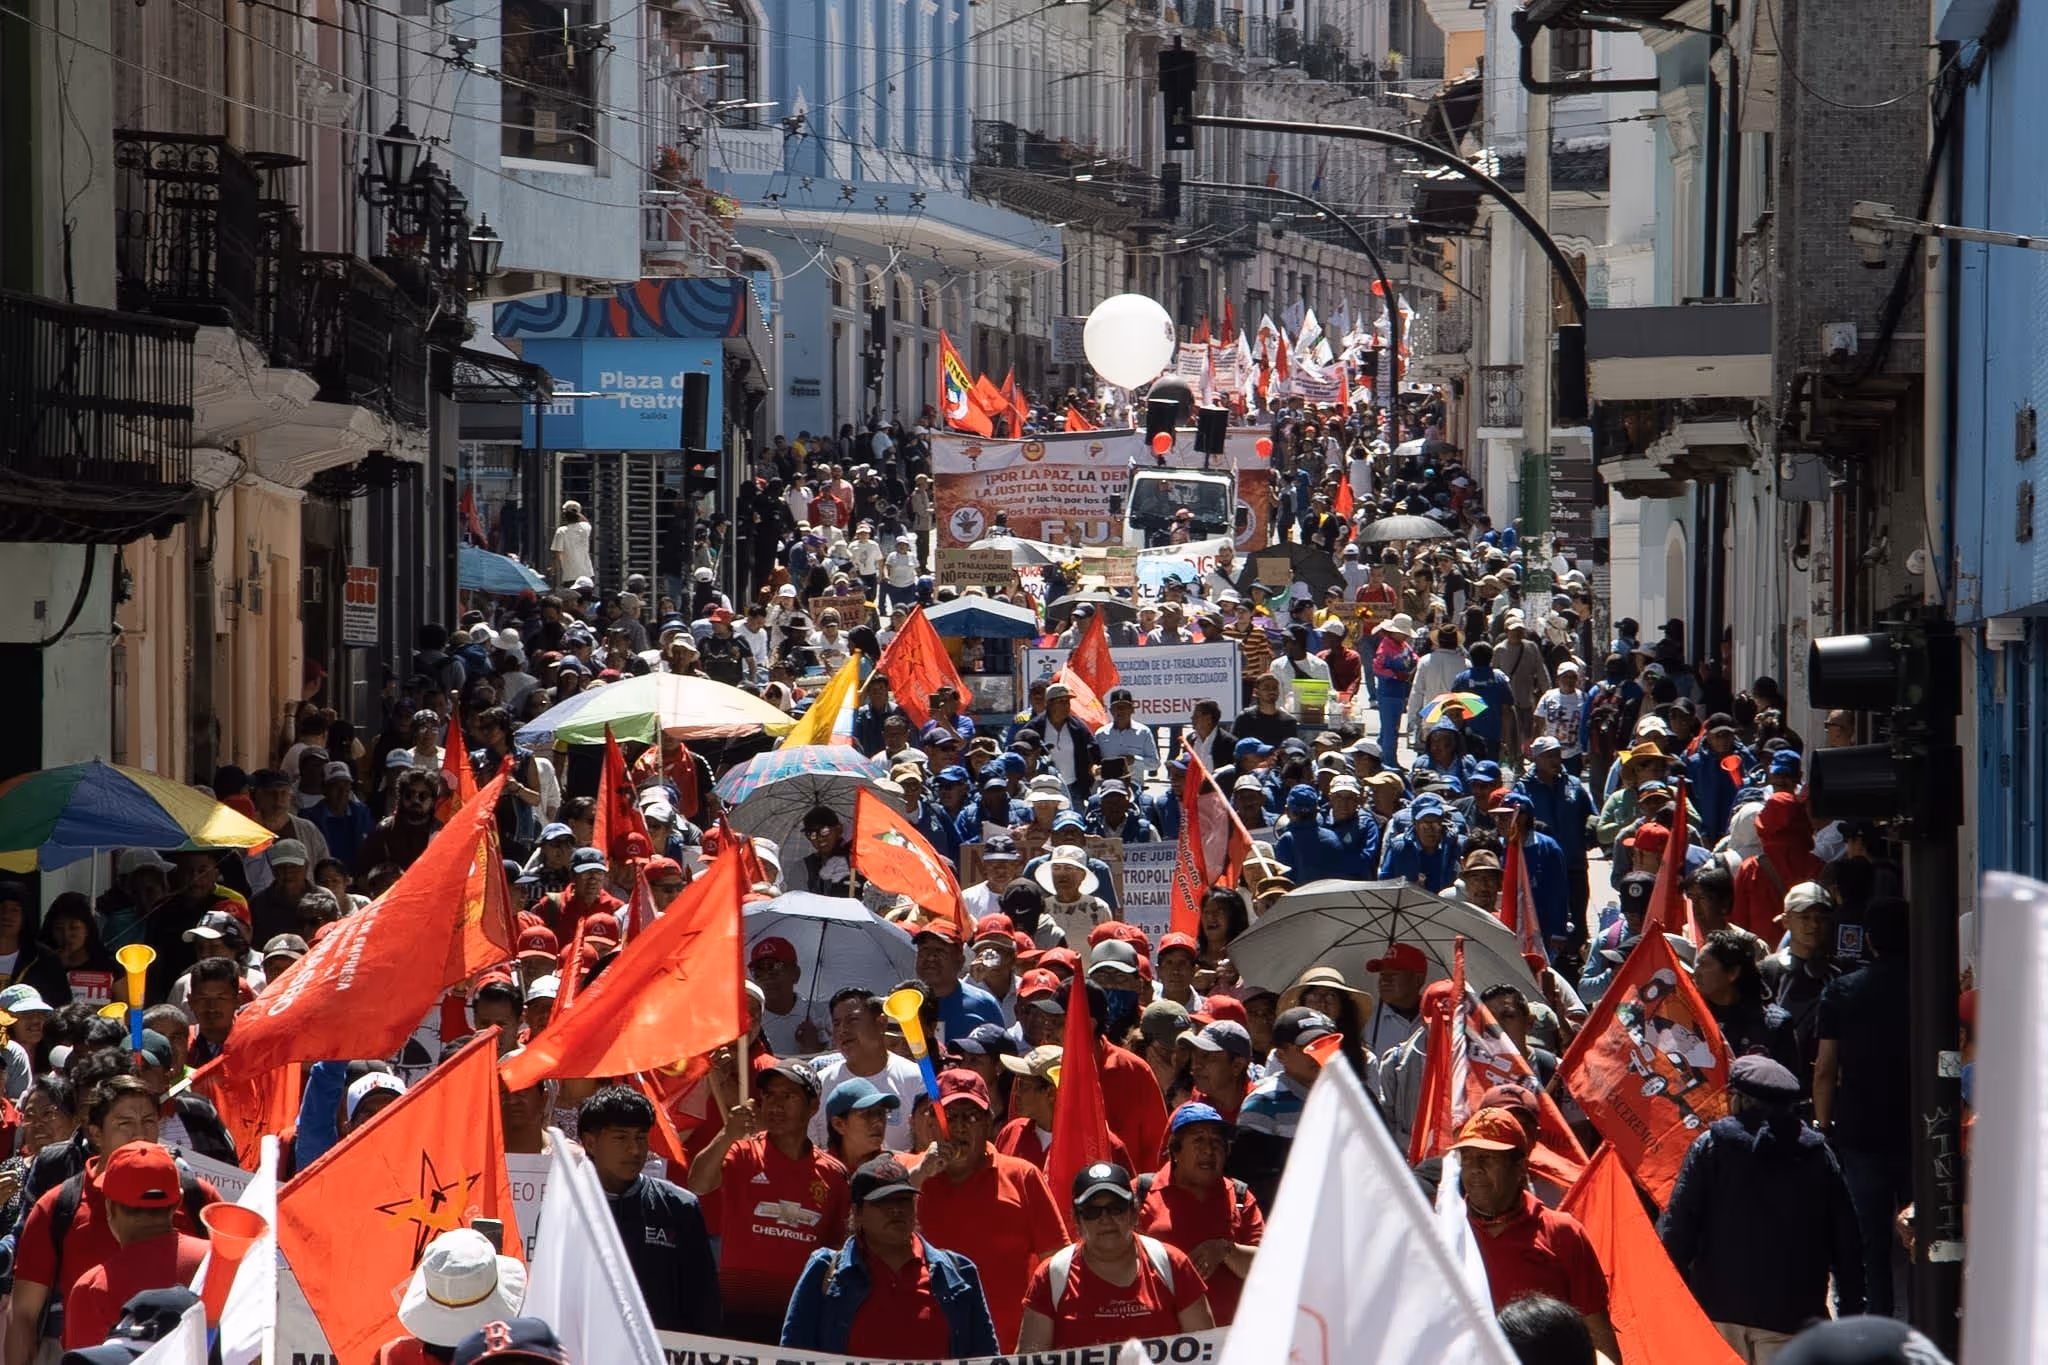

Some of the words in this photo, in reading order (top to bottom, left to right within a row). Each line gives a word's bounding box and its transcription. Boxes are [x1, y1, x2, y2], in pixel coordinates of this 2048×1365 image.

[600, 371, 664, 389] Plaza
[1021, 468, 1040, 481] LA
[1043, 468, 1074, 483] PAZ,
[1078, 470, 1097, 482] LA
[975, 488, 992, 498] LA
[994, 483, 1048, 497] JUSTICIA
[1051, 483, 1098, 494] SOCIAL
[1100, 483, 1109, 493] Y
[1064, 496, 1081, 506] por
[1026, 505, 1106, 518] trabajadores
[940, 570, 957, 585] NO
[1150, 658, 1161, 671] DE
[1161, 656, 1224, 670] EX-TRABAJADORES
[1225, 656, 1234, 668] Y
[1153, 674, 1164, 685] DE
[1175, 671, 1228, 685] PETROECUADOR
[1131, 697, 1203, 714] PRESENT
[1131, 851, 1147, 862] DE
[1123, 891, 1170, 906] ANEAMI
